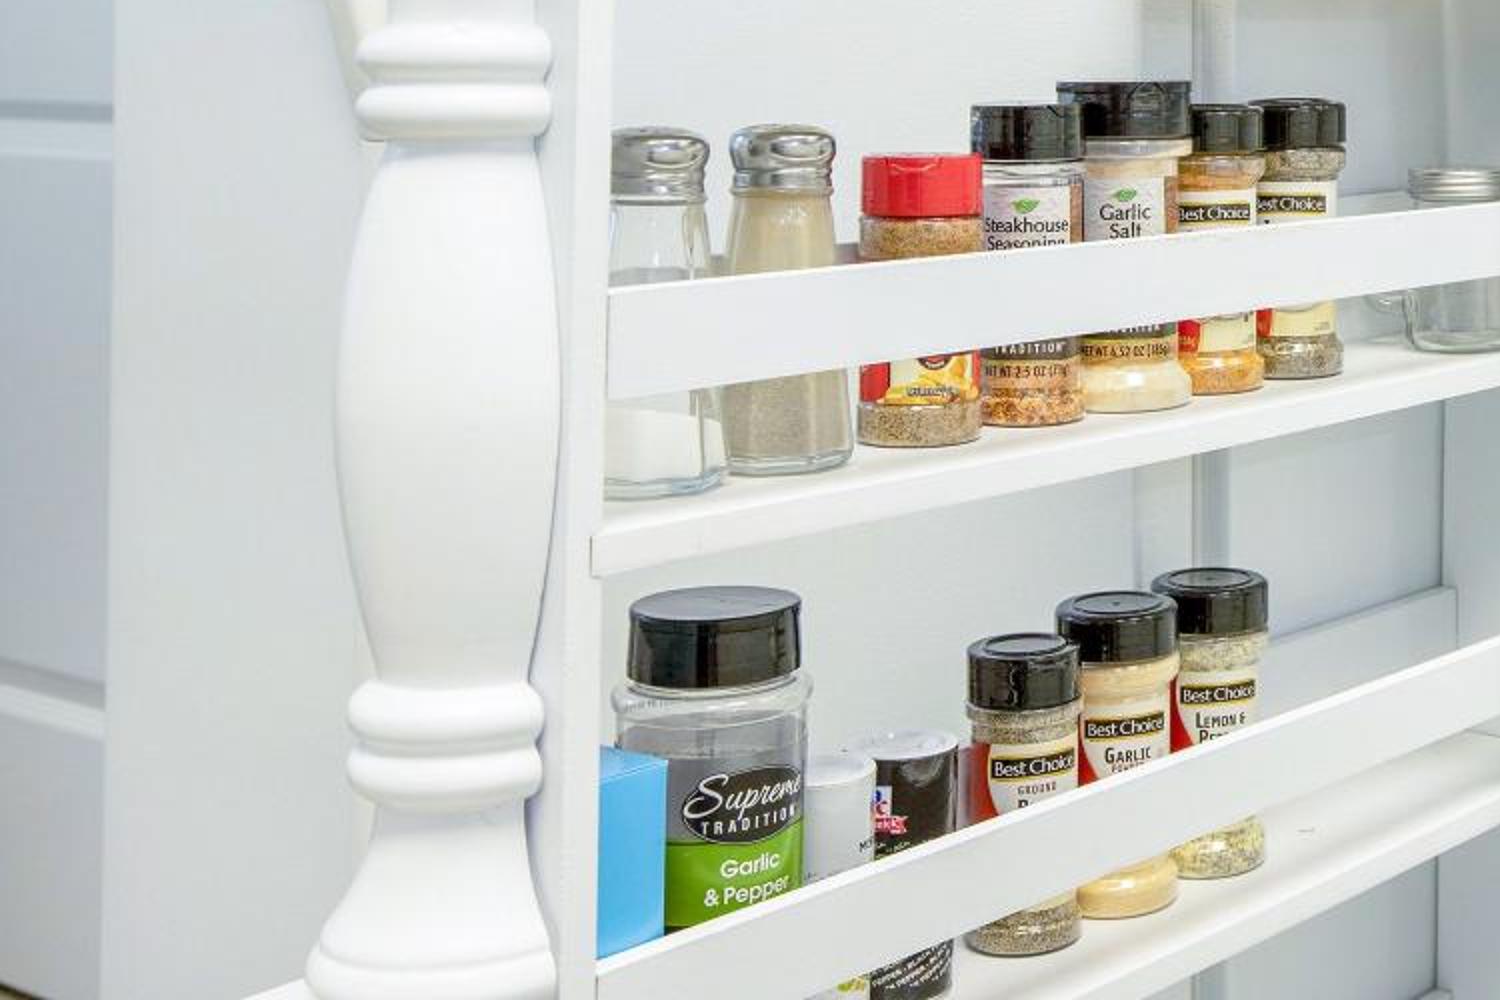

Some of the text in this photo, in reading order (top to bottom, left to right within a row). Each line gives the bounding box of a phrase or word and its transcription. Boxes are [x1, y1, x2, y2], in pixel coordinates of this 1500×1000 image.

[1099, 203, 1152, 220] Garlic
[1207, 206, 1249, 220] Choice
[1279, 197, 1325, 211] Choice
[984, 216, 1069, 233] Steakhouse
[1109, 221, 1142, 239] Salt
[1183, 685, 1255, 703] Best Choice
[1088, 718, 1164, 737] Best Choice
[1104, 746, 1151, 764] GARLIC
[995, 755, 1075, 777] Best Choice
[701, 803, 796, 835] TRADITION
[721, 852, 781, 878] Garlic
[703, 875, 790, 907] & Pepper
